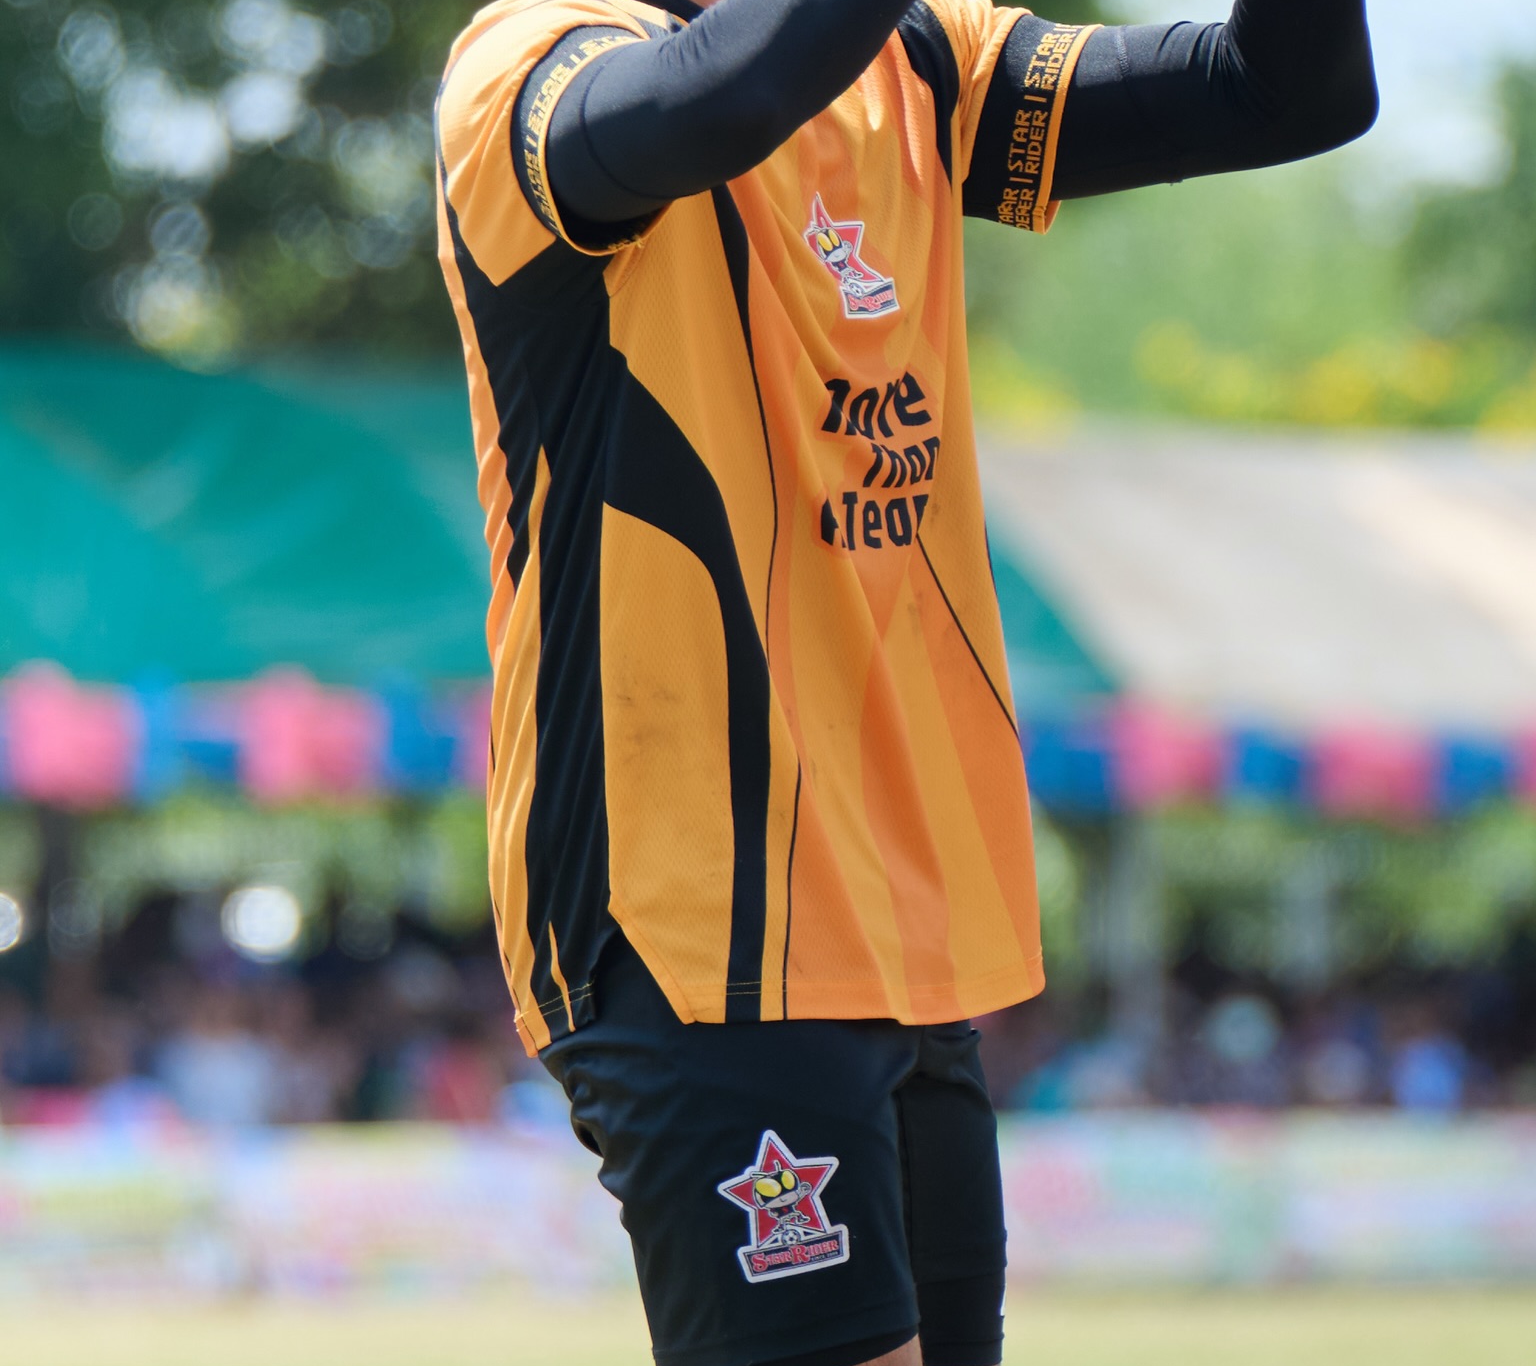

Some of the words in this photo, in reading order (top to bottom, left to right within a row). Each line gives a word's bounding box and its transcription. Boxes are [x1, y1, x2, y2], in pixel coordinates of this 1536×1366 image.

[1024, 32, 1060, 88] STAR
[1042, 30, 1077, 91] RIDER
[1008, 109, 1032, 173] STAR
[1025, 111, 1049, 175] RIDER
